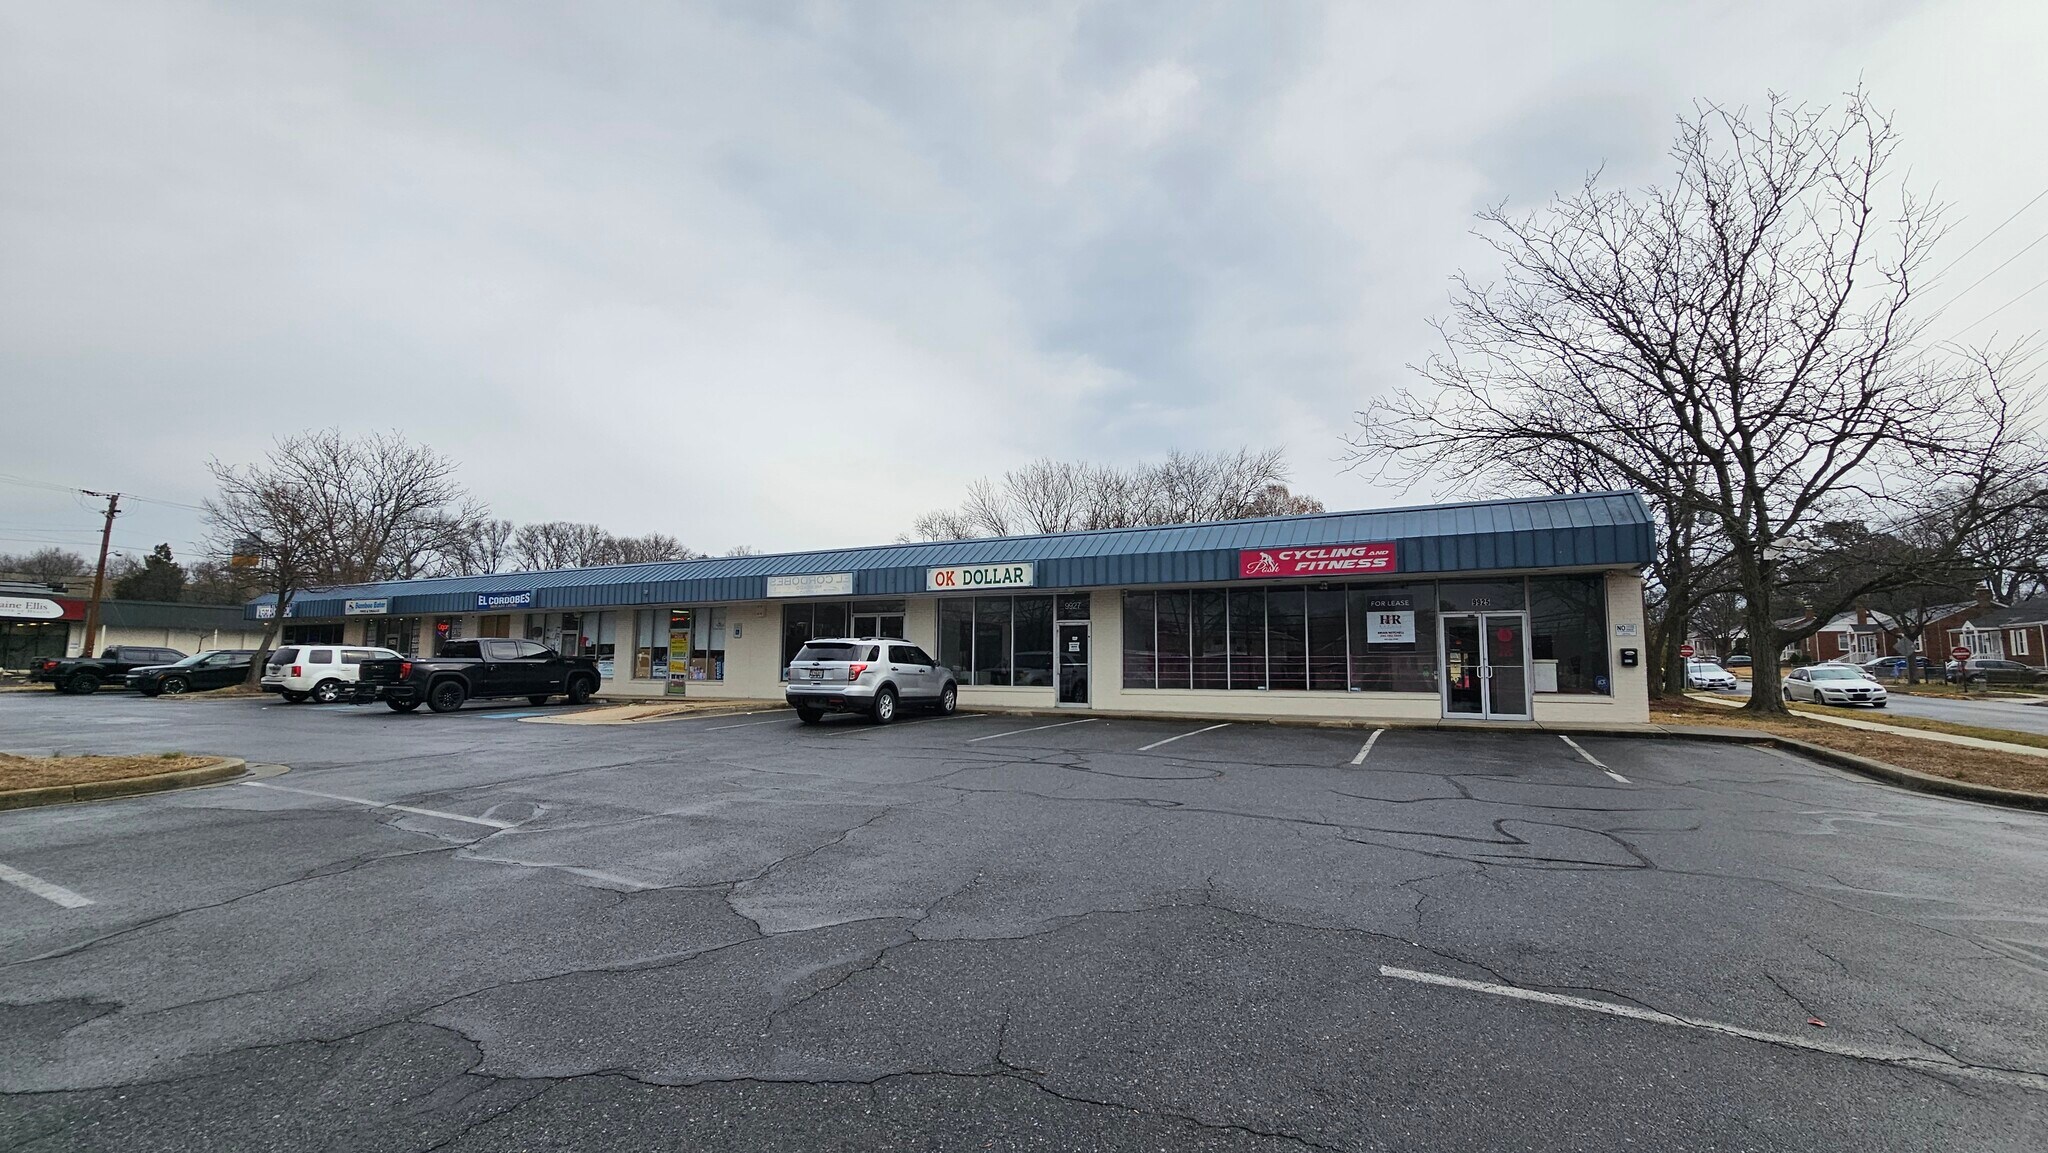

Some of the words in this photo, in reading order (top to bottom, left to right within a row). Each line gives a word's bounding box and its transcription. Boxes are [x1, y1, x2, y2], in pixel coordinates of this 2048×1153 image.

[1279, 547, 1367, 560] CYCLING
[1295, 558, 1389, 571] FITNESS
[935, 571, 955, 586] OK
[963, 567, 1024, 585] DOLLAR
[478, 595, 487, 606] EL
[488, 592, 530, 605] CORDOBES
[25, 602, 48, 610] Ellis
[1064, 602, 1081, 610] 9927
